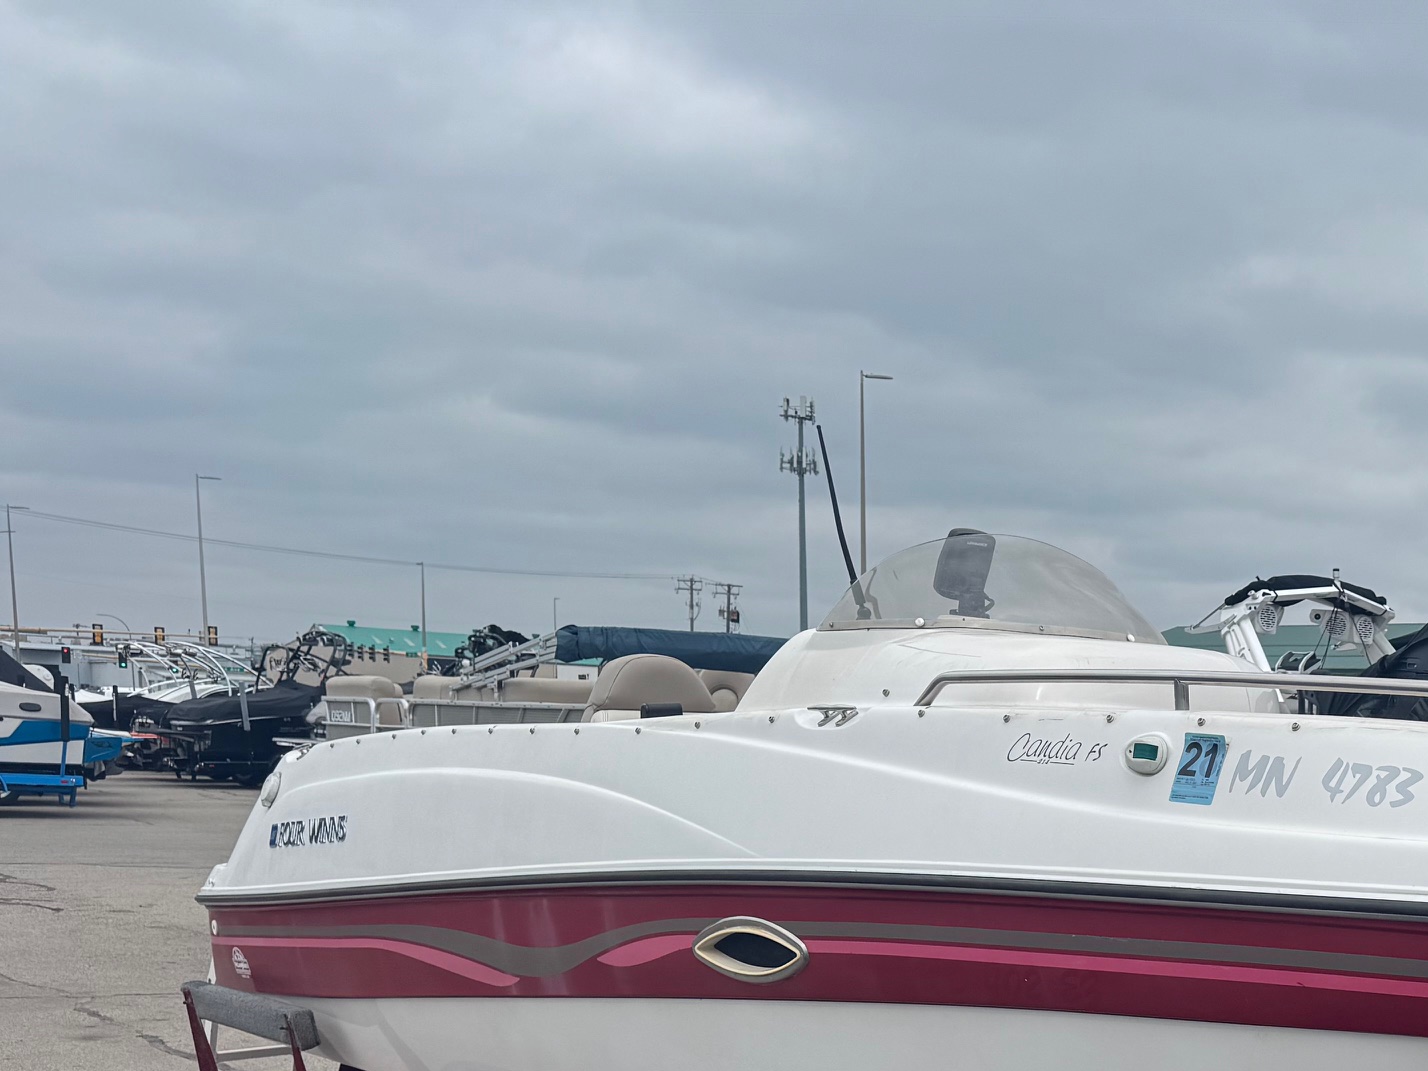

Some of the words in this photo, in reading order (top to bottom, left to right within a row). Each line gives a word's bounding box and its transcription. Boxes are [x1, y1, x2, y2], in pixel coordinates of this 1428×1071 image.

[1007, 732, 1082, 762] Candia
[1084, 743, 1108, 762] FS
[1178, 741, 1219, 778] 21
[1229, 749, 1302, 798] MN
[1321, 757, 1424, 808] 4783
[278, 820, 305, 847] FOUR
[308, 815, 347, 844] WINNS
